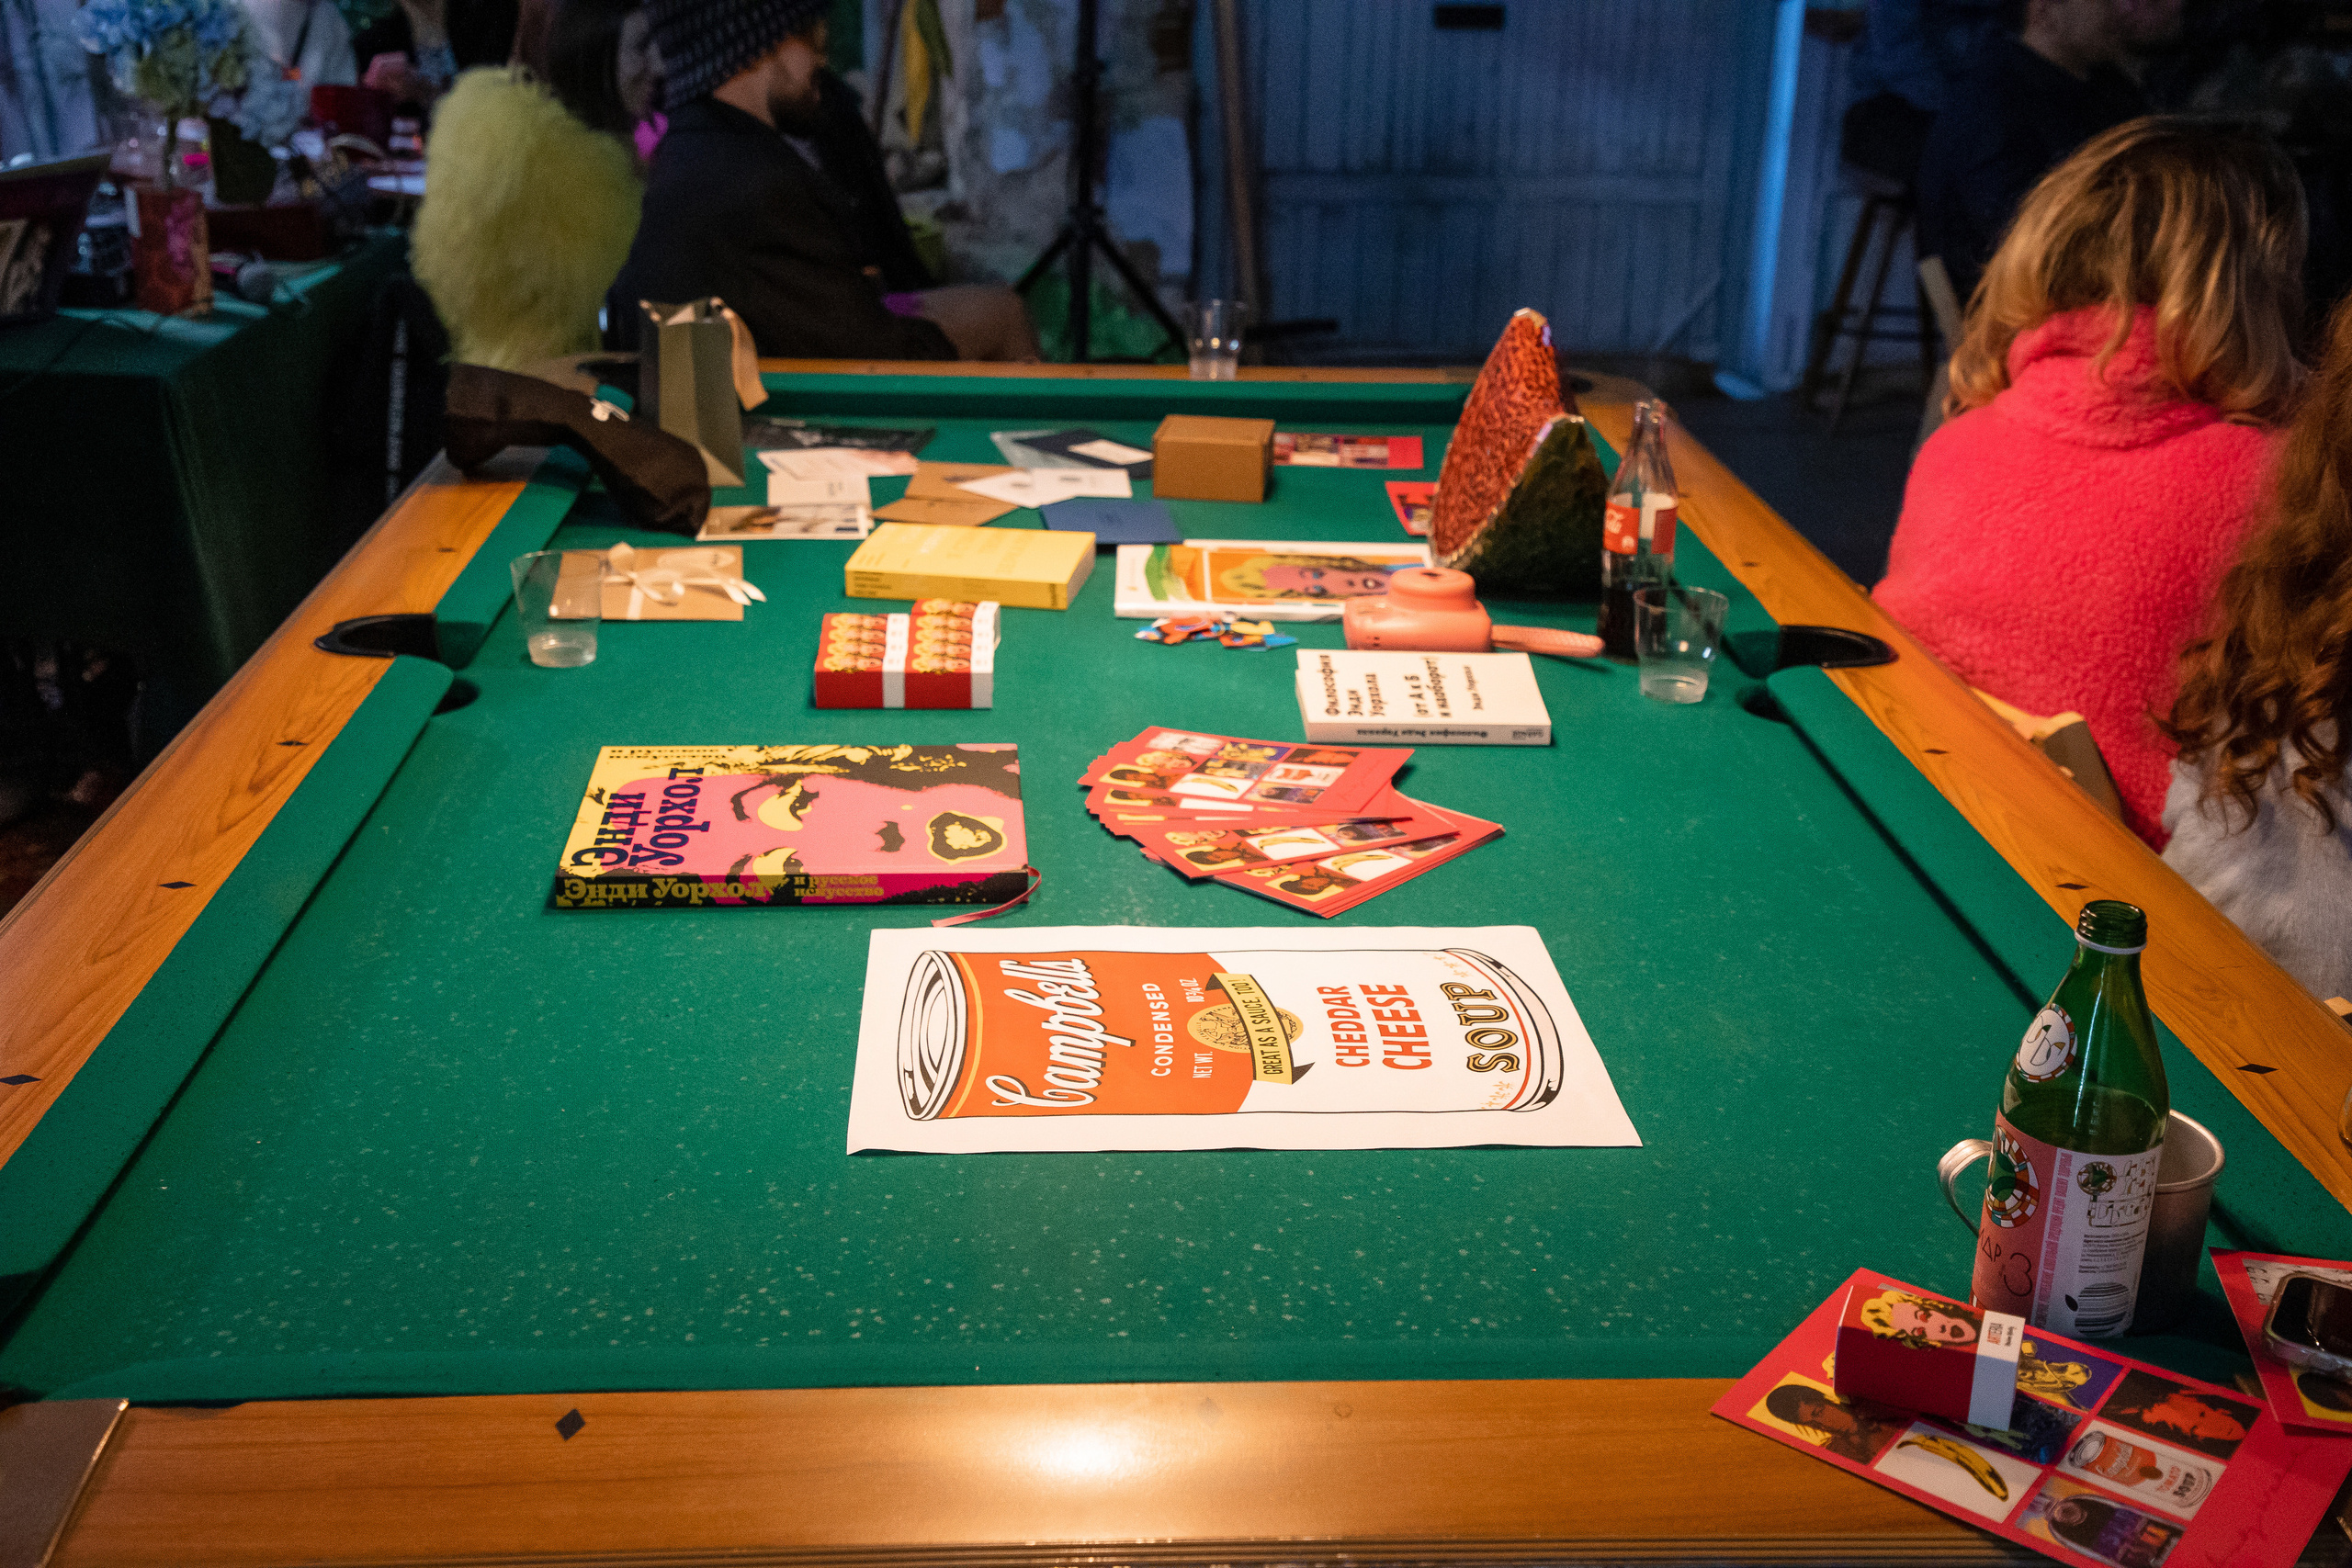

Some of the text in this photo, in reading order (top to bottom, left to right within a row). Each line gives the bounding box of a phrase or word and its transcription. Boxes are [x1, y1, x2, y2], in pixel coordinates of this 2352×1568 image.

[1346, 689, 1363, 716] Энди
[570, 793, 651, 866] Энди
[628, 767, 711, 866] Уорхол
[564, 877, 773, 905] Энди Уорхол
[808, 874, 879, 889] русское
[1242, 996, 1272, 1025] SAUCE,
[1142, 983, 1174, 1077] CONDENSED
[1317, 985, 1371, 1068] CHEDDAR
[1357, 984, 1433, 1071] CHEESE
[1439, 982, 1521, 1074] SOUP
[1257, 1036, 1278, 1047] AS
[1192, 1065, 1214, 1079] NET
[1193, 1051, 1214, 1065] WT.
[1260, 1049, 1284, 1075] GREAT
